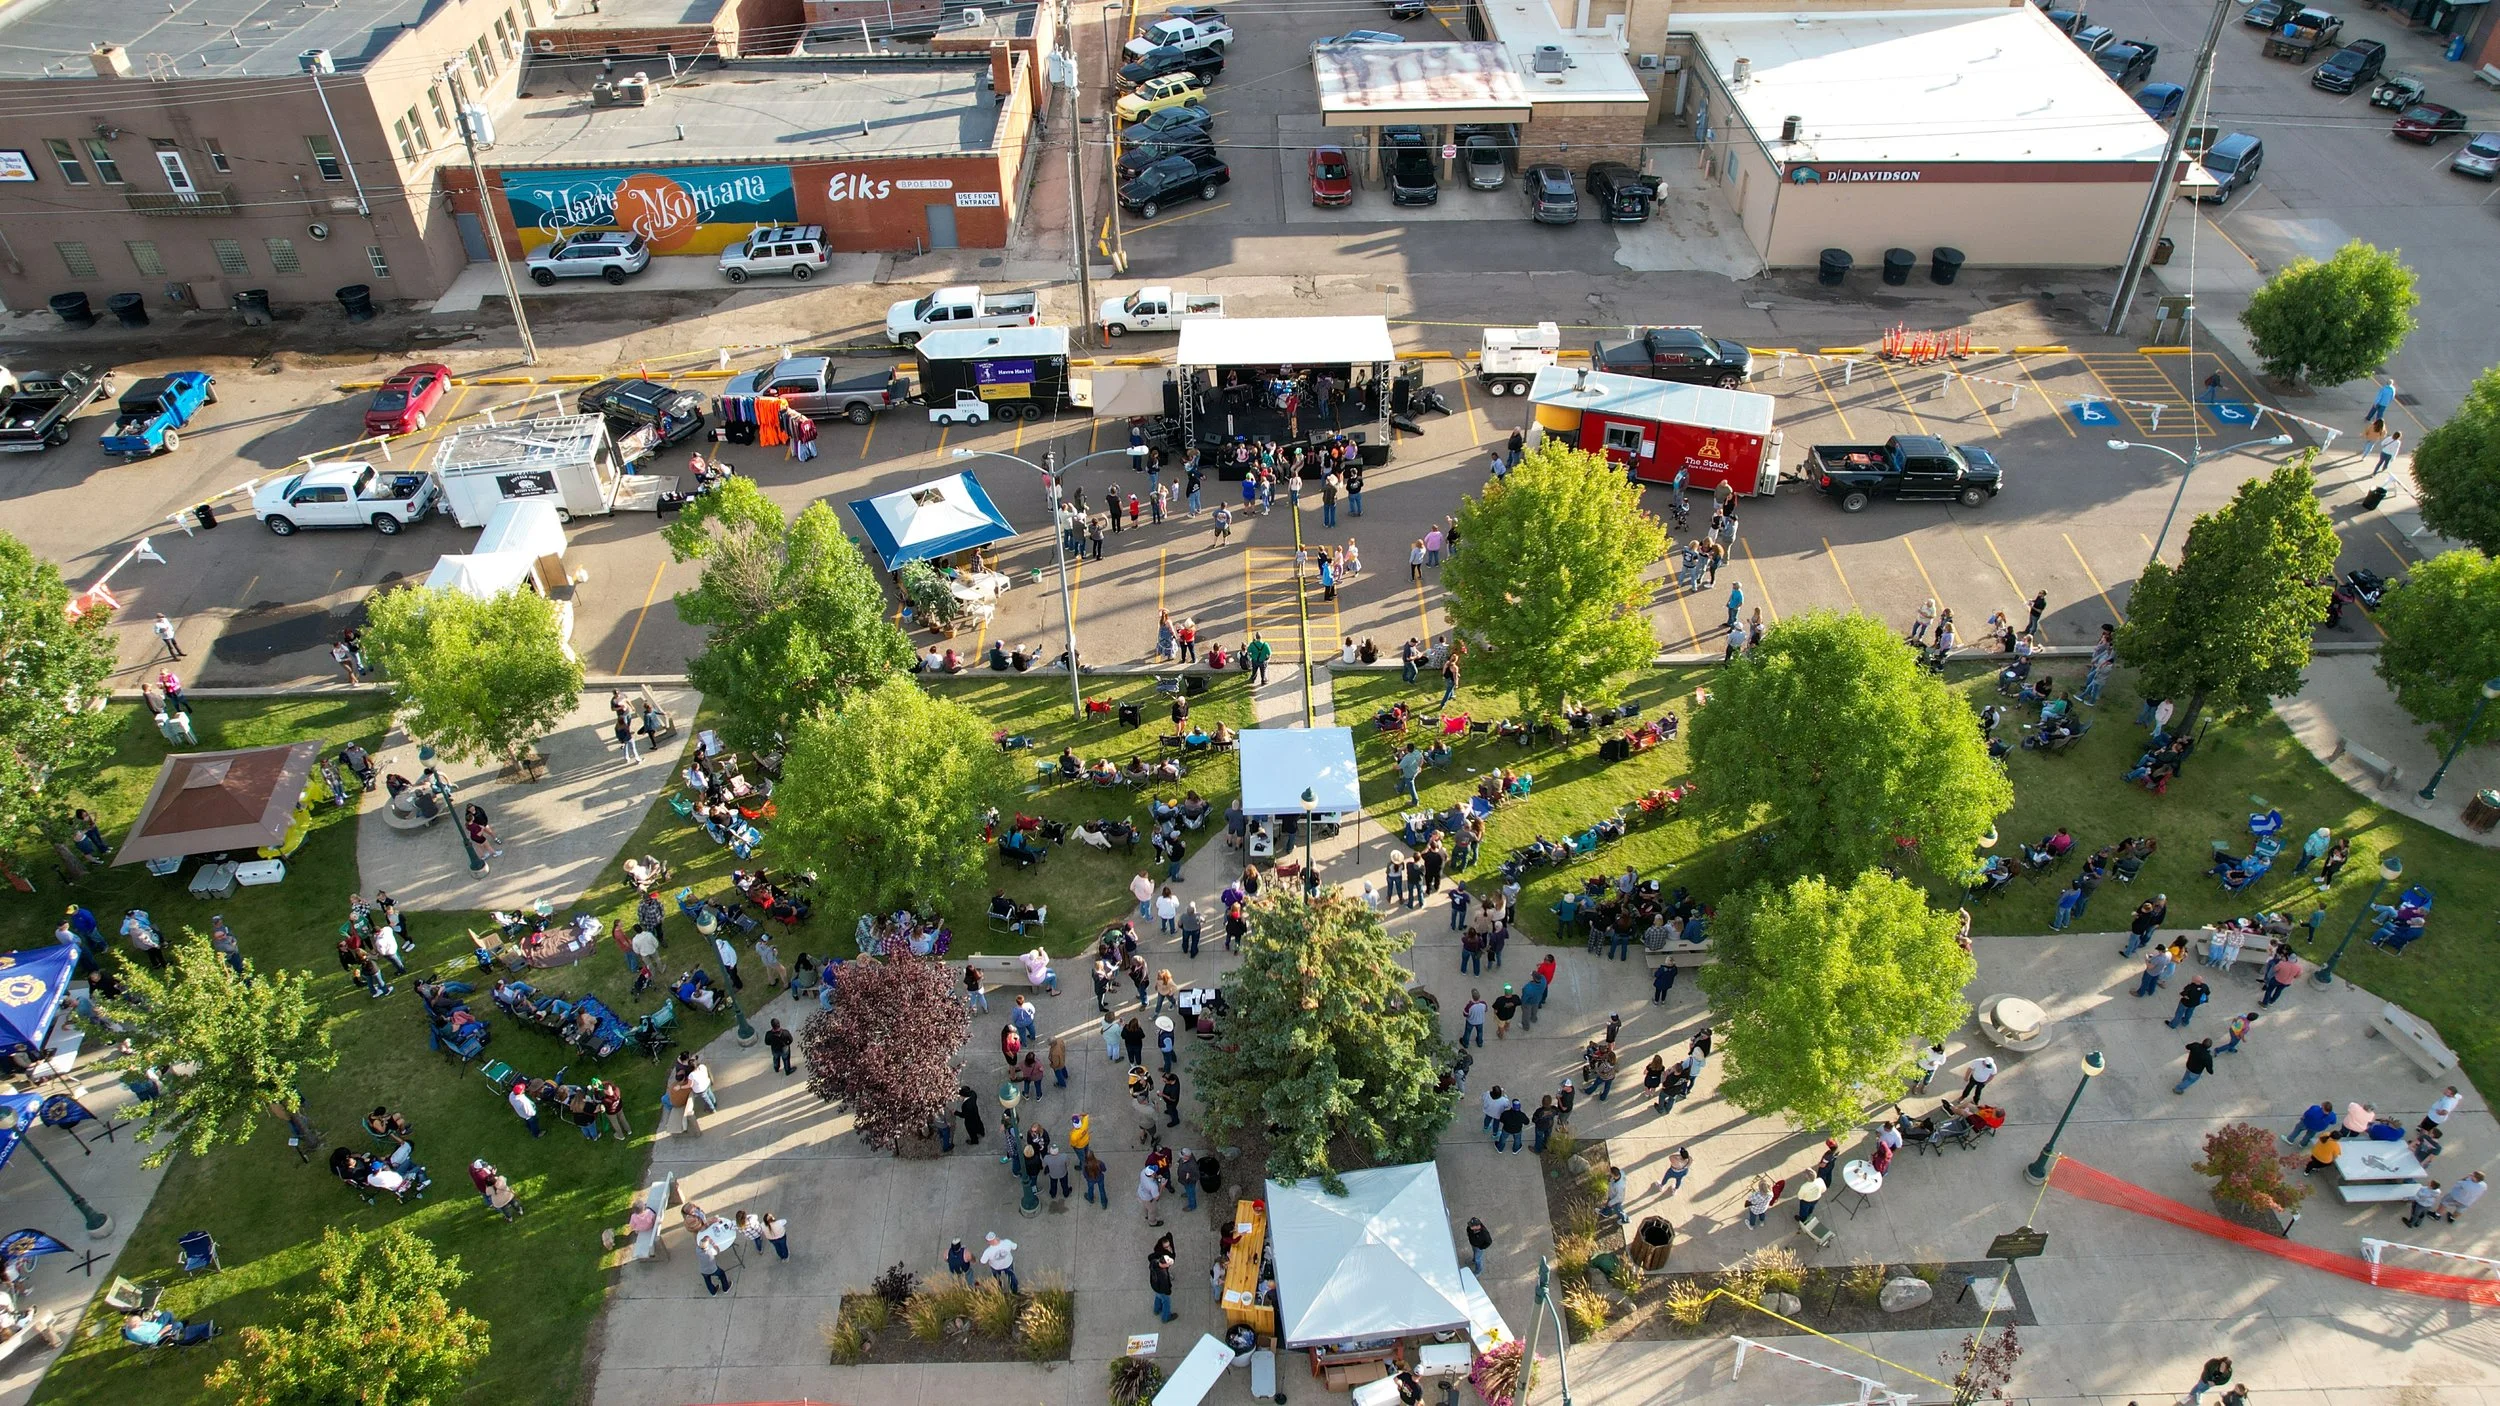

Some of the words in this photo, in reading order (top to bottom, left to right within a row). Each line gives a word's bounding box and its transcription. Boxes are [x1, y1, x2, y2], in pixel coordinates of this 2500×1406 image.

[828, 172, 891, 202] Elks
[533, 176, 628, 244] Havre
[628, 174, 771, 242] Montana
[1685, 457, 1701, 465] The
[1703, 460, 1729, 469] Stack
